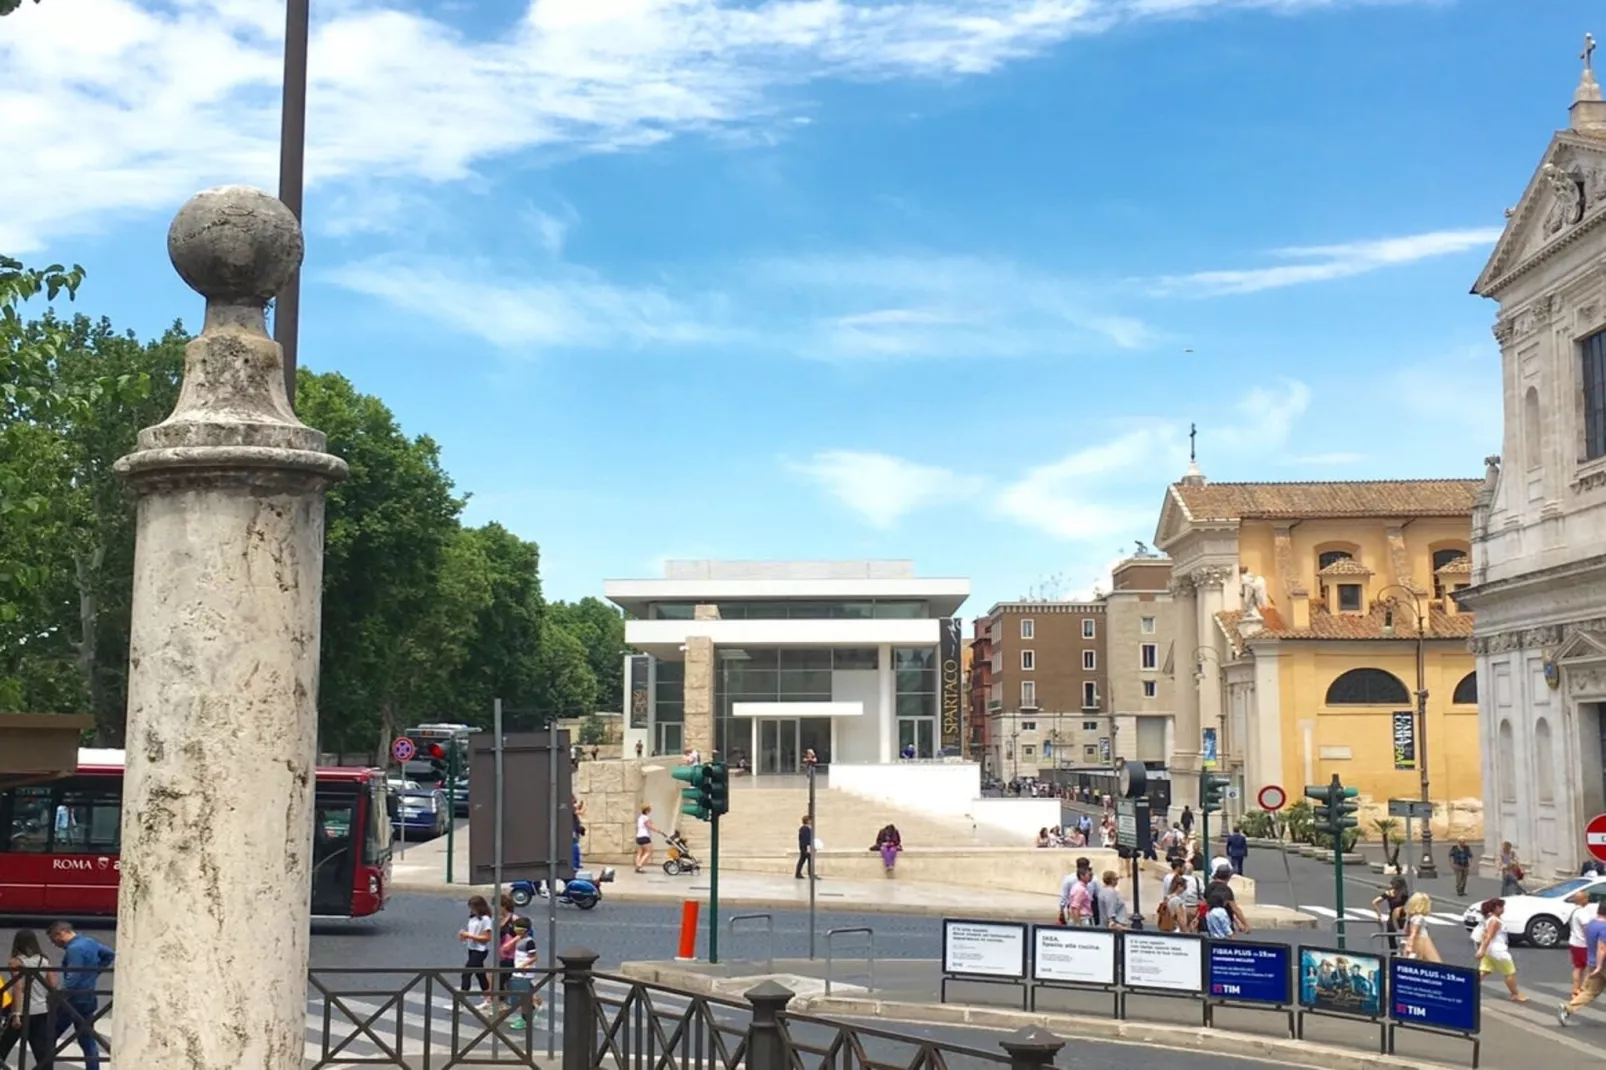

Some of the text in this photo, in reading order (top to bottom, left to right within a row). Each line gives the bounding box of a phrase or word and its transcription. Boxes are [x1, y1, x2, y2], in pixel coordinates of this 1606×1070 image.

[943, 660, 958, 734] SPARTACO
[53, 859, 92, 869] ROMA
[1234, 949, 1252, 957] PLUS
[1397, 965, 1419, 975] FIBRA
[1420, 969, 1439, 979] PLUS
[1222, 984, 1241, 994] TIM
[1407, 1004, 1427, 1017] TIM
